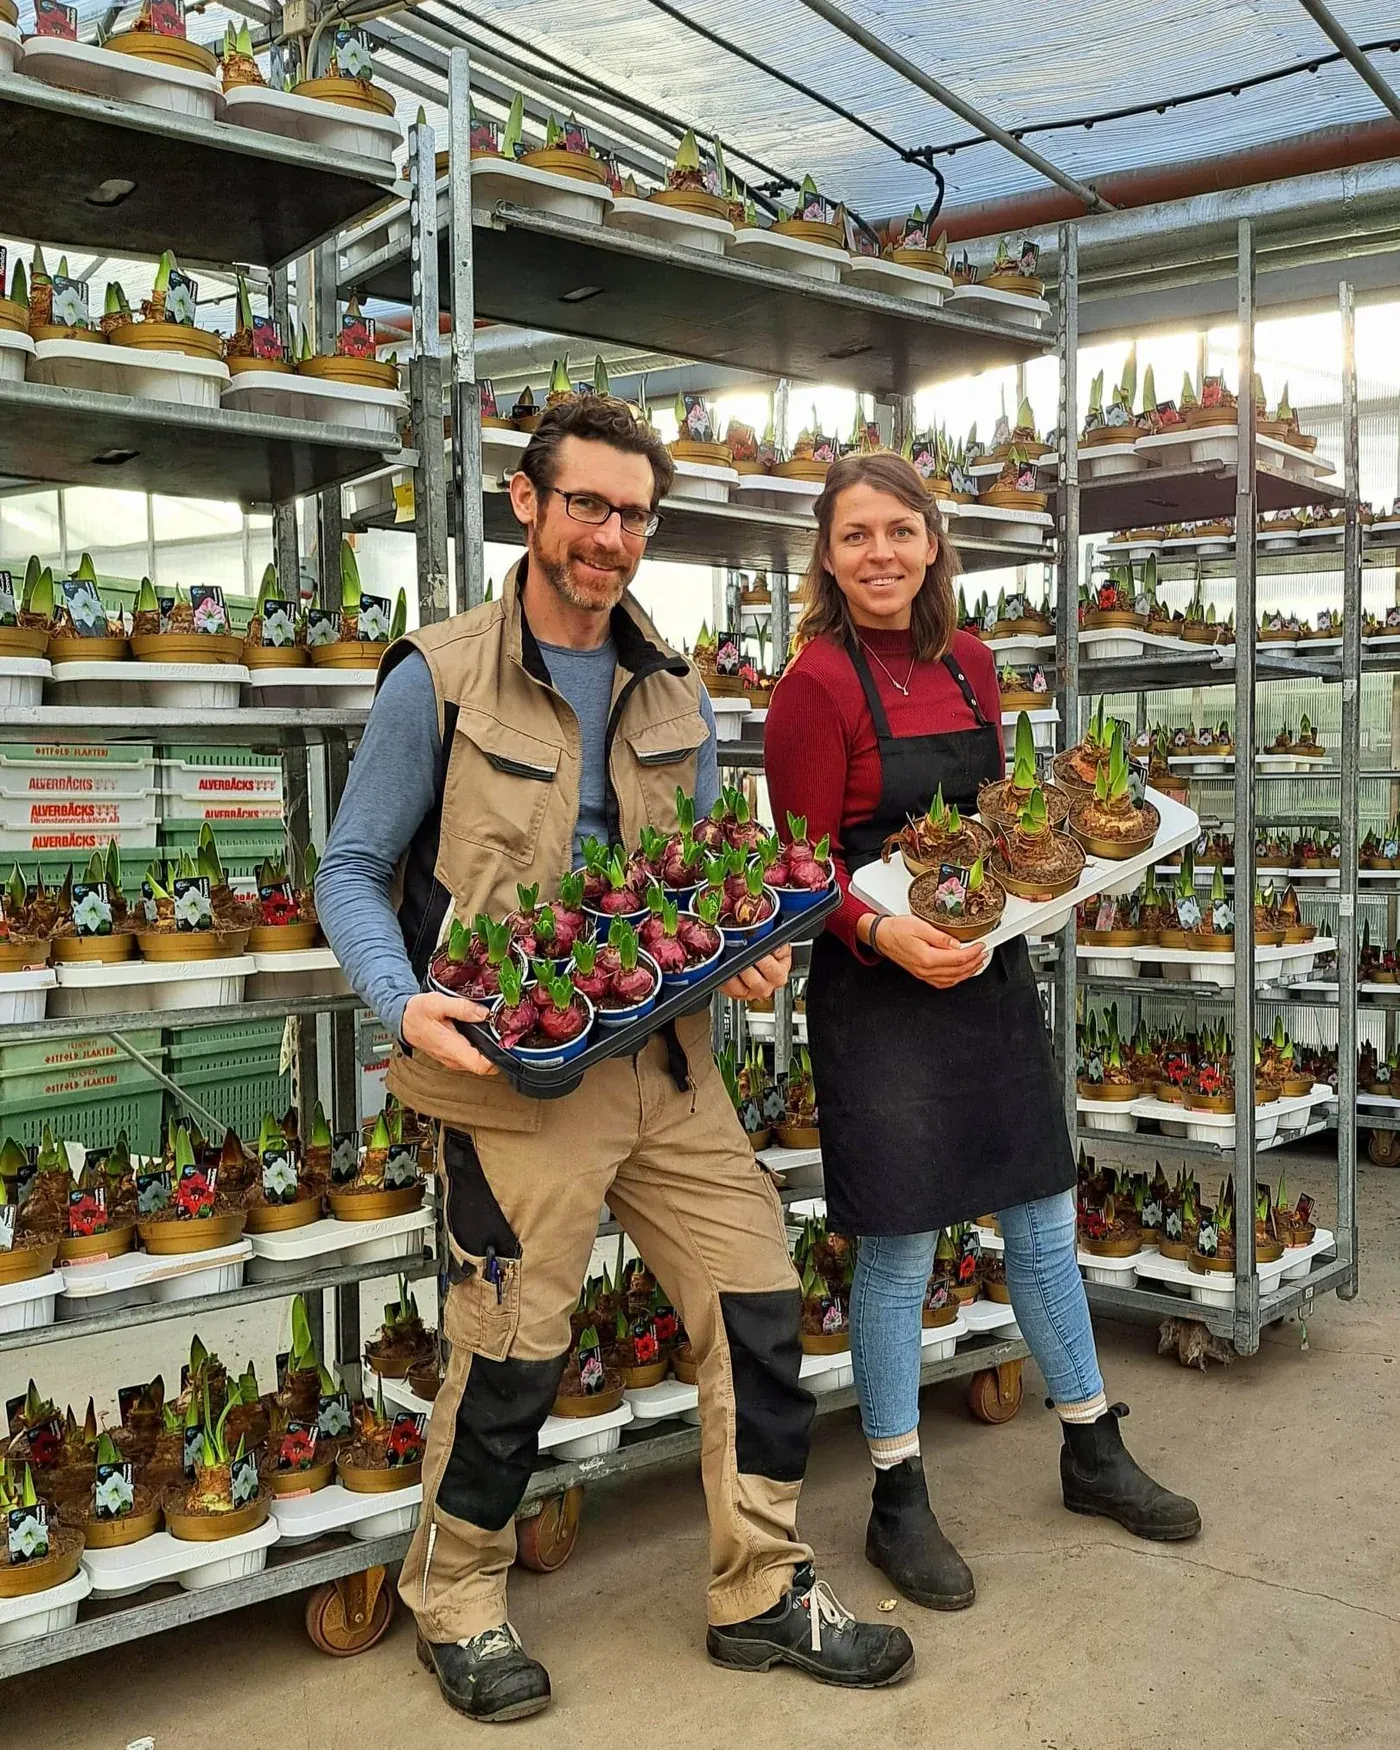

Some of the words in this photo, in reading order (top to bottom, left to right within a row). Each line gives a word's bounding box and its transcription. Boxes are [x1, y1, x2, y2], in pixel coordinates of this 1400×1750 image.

[29, 776, 93, 791] ALVERBÄCKS
[198, 777, 254, 791] ALVERBÄCKS
[31, 802, 95, 816] ALVERBÄCKS
[31, 832, 96, 848] ALVERBÄCKS
